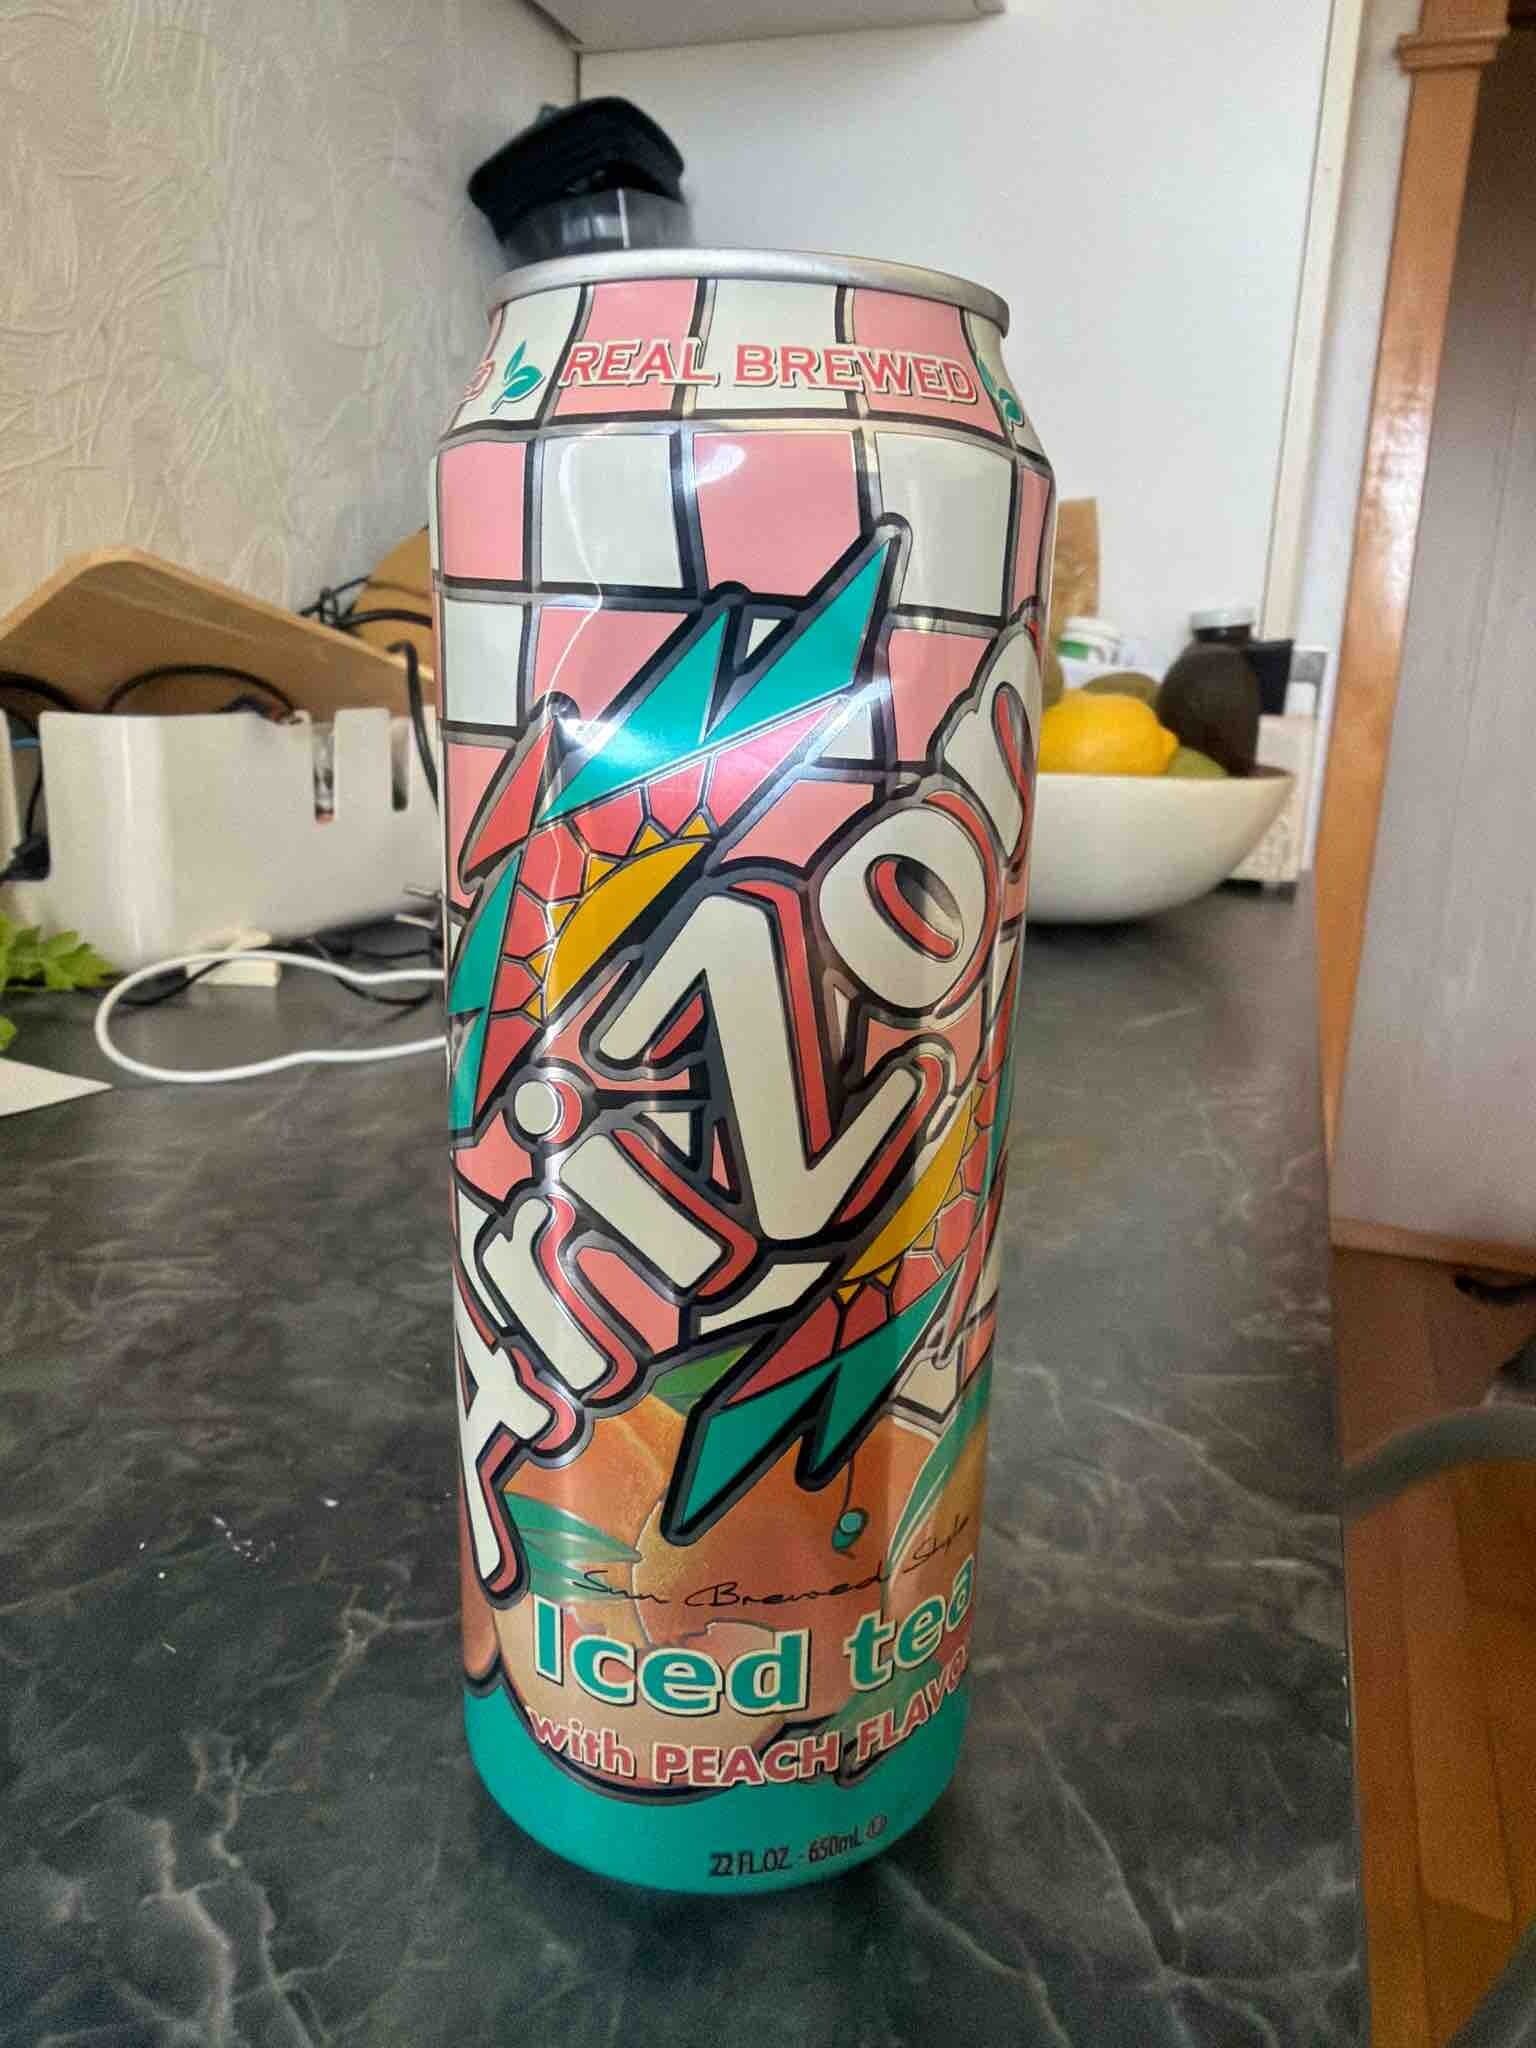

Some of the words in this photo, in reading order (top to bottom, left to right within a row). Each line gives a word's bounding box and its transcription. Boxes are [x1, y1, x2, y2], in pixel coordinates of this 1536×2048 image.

[556, 339, 719, 387] REAL
[733, 340, 978, 404] BREWED
[572, 1570, 668, 1603] Sun
[684, 1560, 892, 1607] Brewed
[530, 1592, 811, 1718] Iced
[841, 1553, 974, 1691] tea
[525, 1704, 636, 1777] with
[652, 1736, 841, 1788] PEACH
[709, 1851, 734, 1877] 22
[807, 1825, 863, 1862] 650mL
